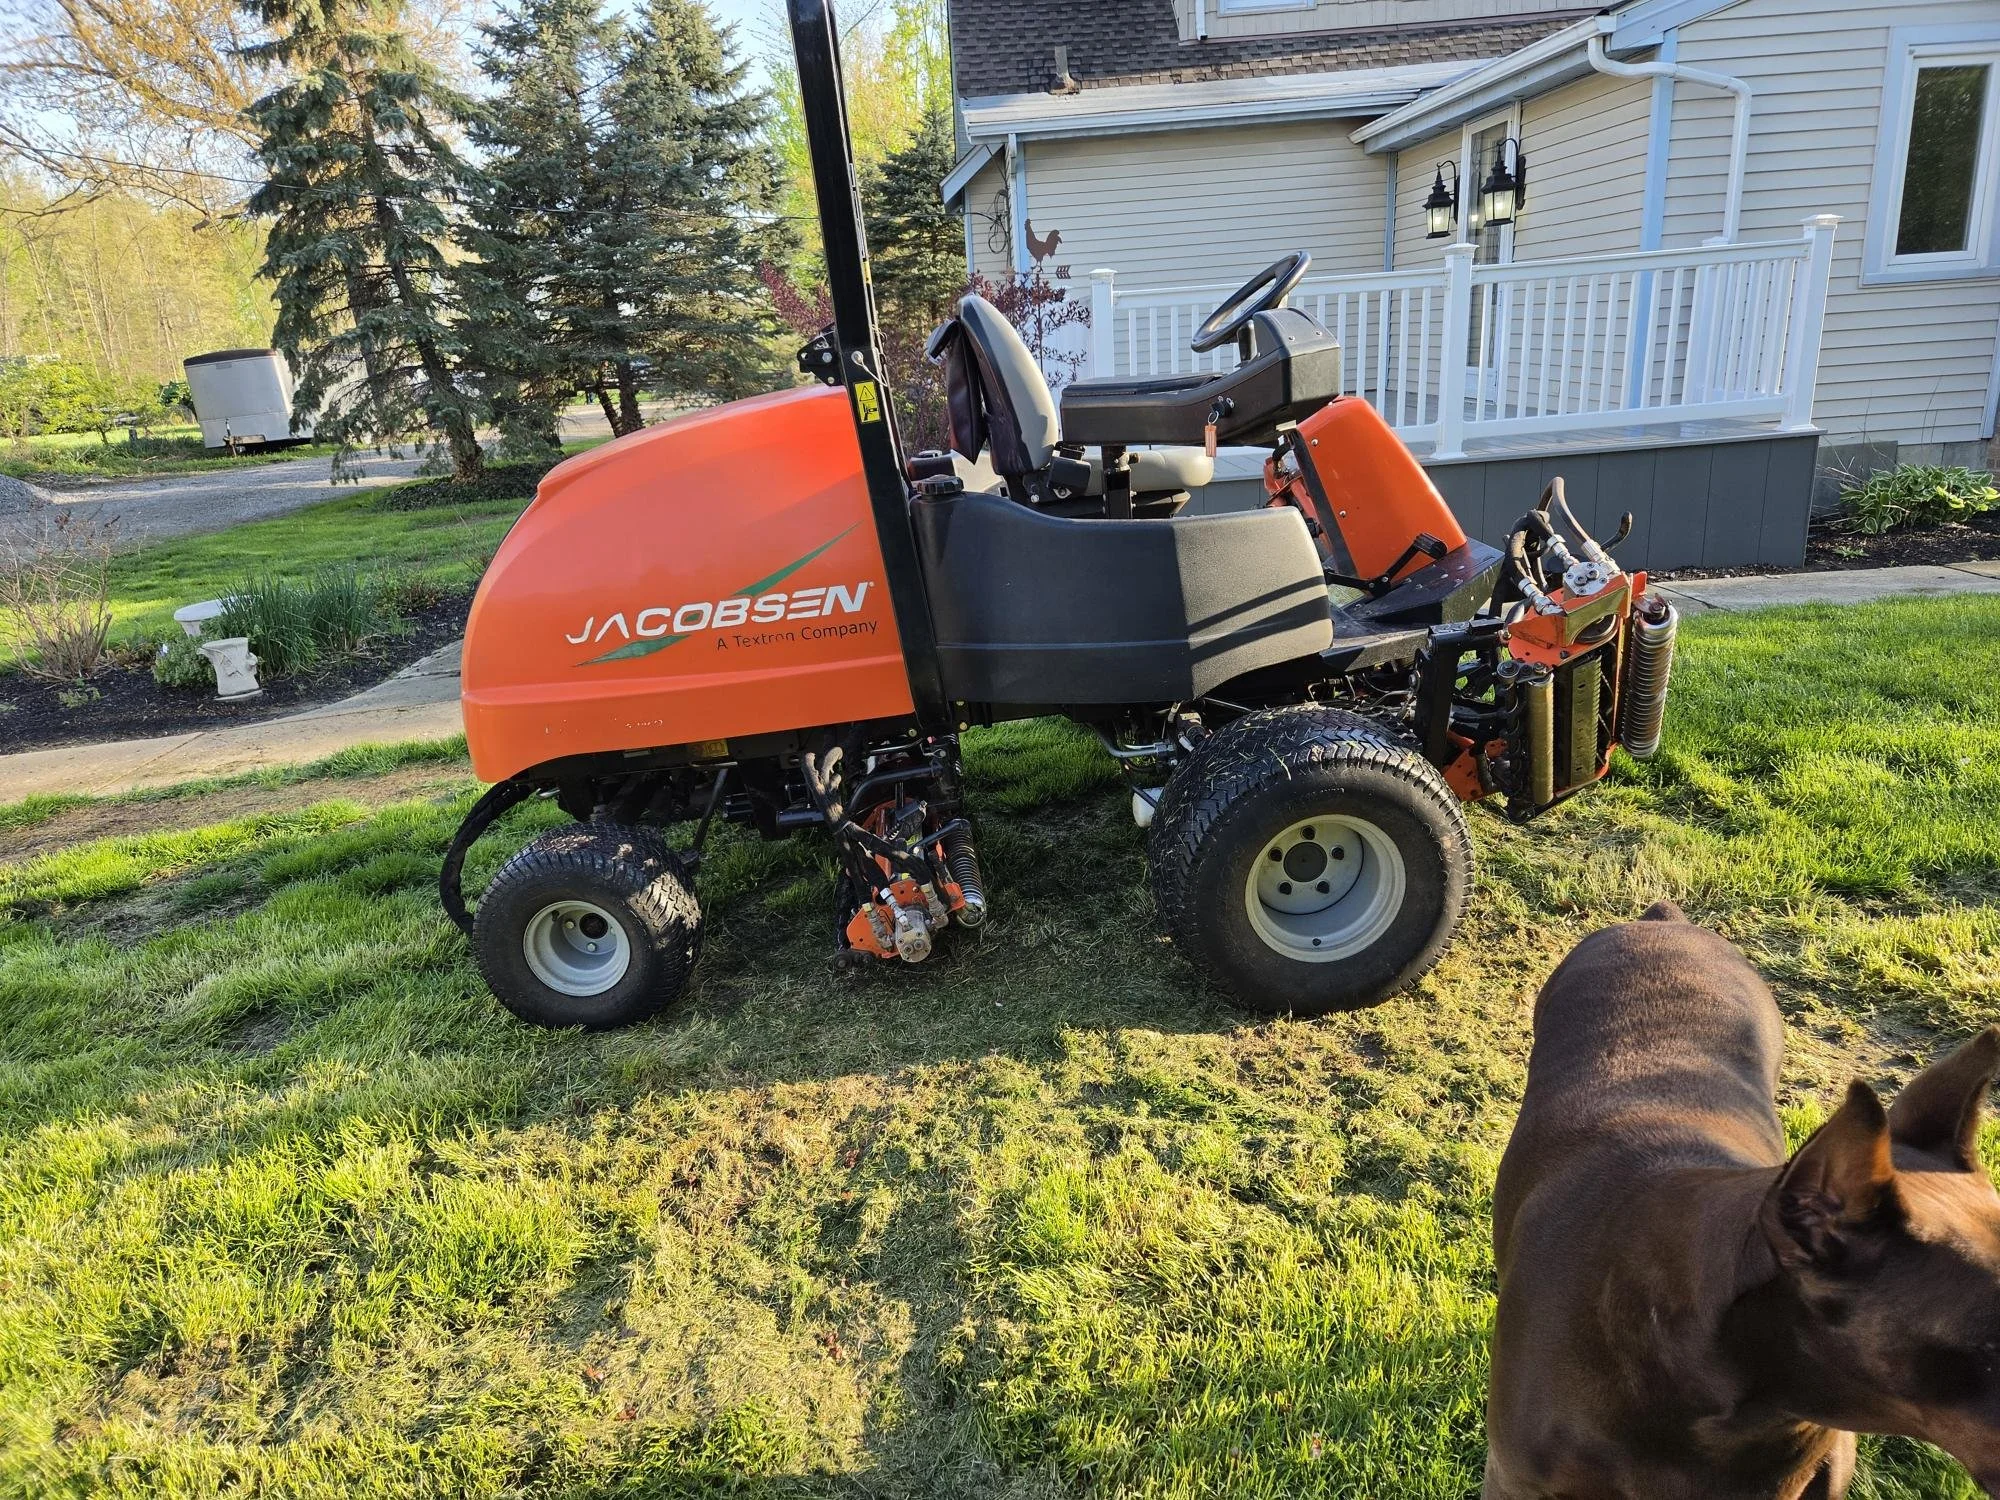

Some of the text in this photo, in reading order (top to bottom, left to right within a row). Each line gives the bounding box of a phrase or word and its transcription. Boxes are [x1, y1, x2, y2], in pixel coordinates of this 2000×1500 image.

[565, 582, 869, 644] JACOBSEN
[717, 637, 729, 651] A
[801, 620, 878, 641] Company
